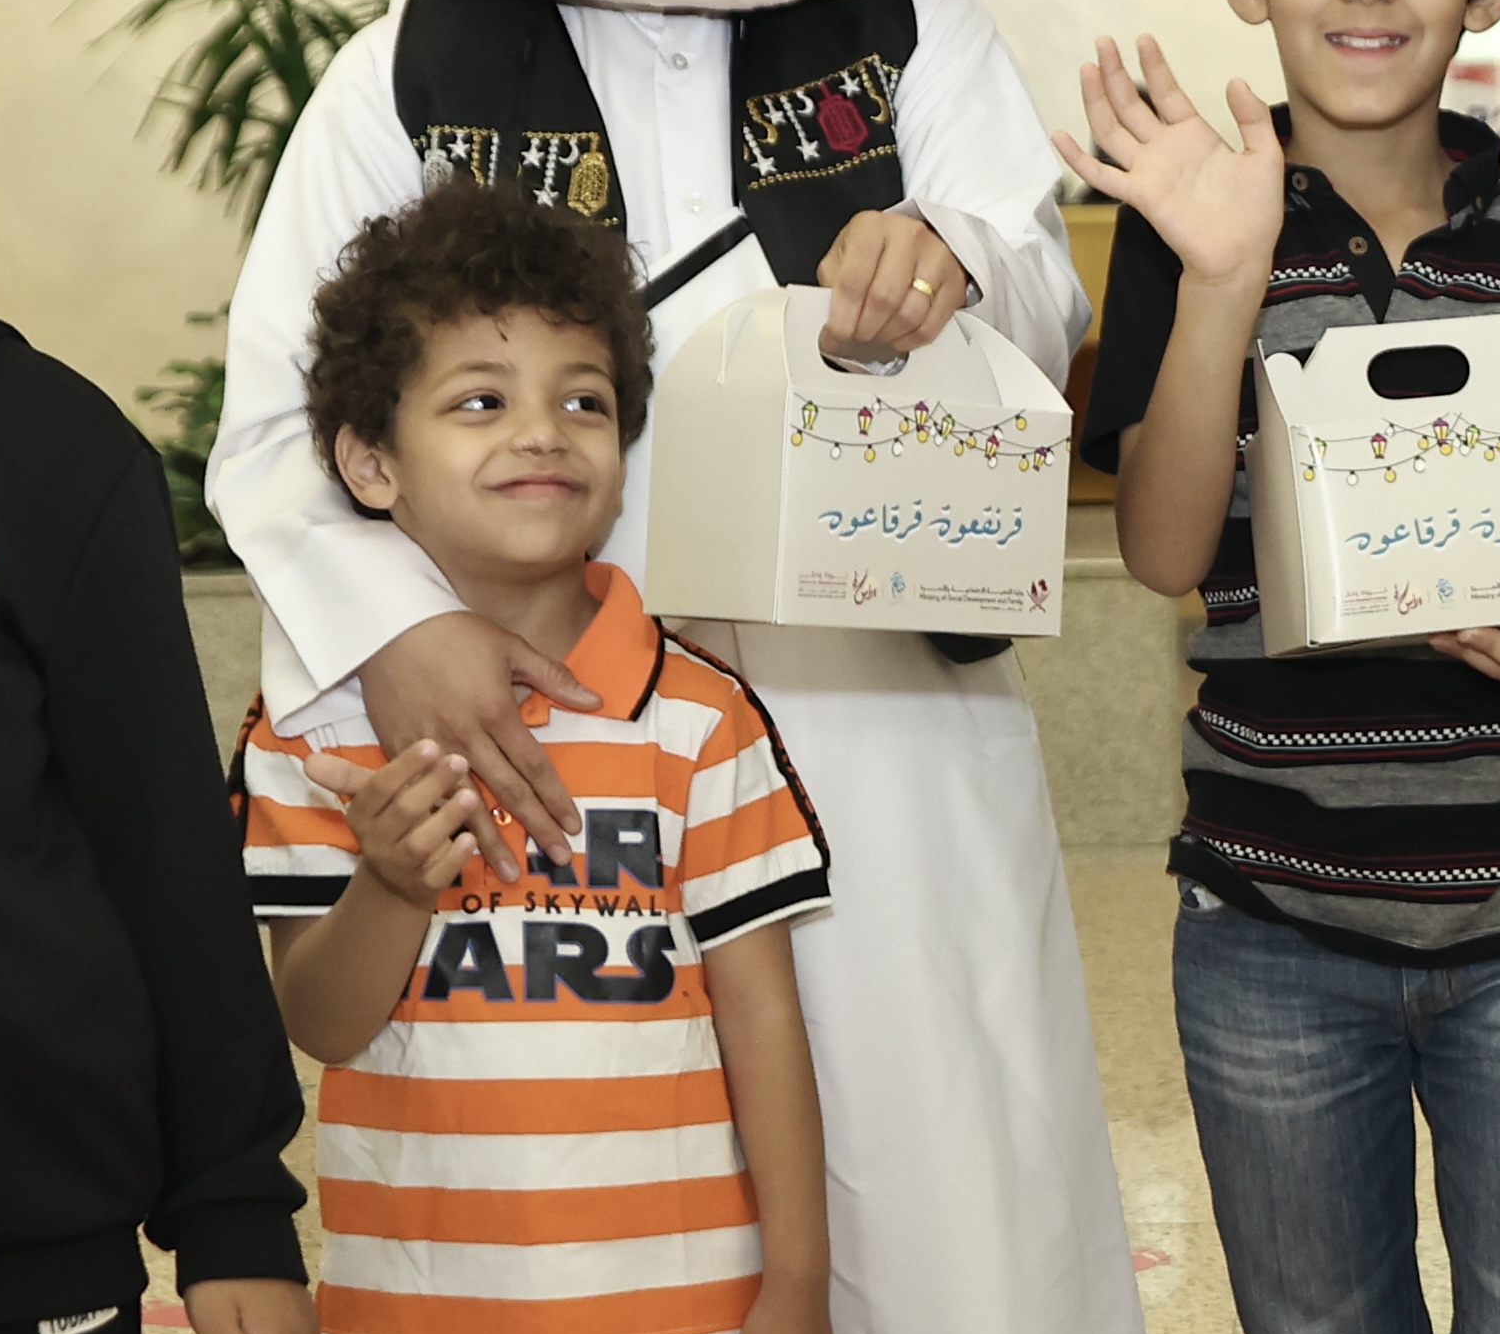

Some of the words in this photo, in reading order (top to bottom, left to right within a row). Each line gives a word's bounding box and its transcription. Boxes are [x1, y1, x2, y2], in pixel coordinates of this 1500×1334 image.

[461, 892, 503, 914] OF
[524, 891, 662, 917] SKYWAL
[419, 920, 678, 1004] ARS
